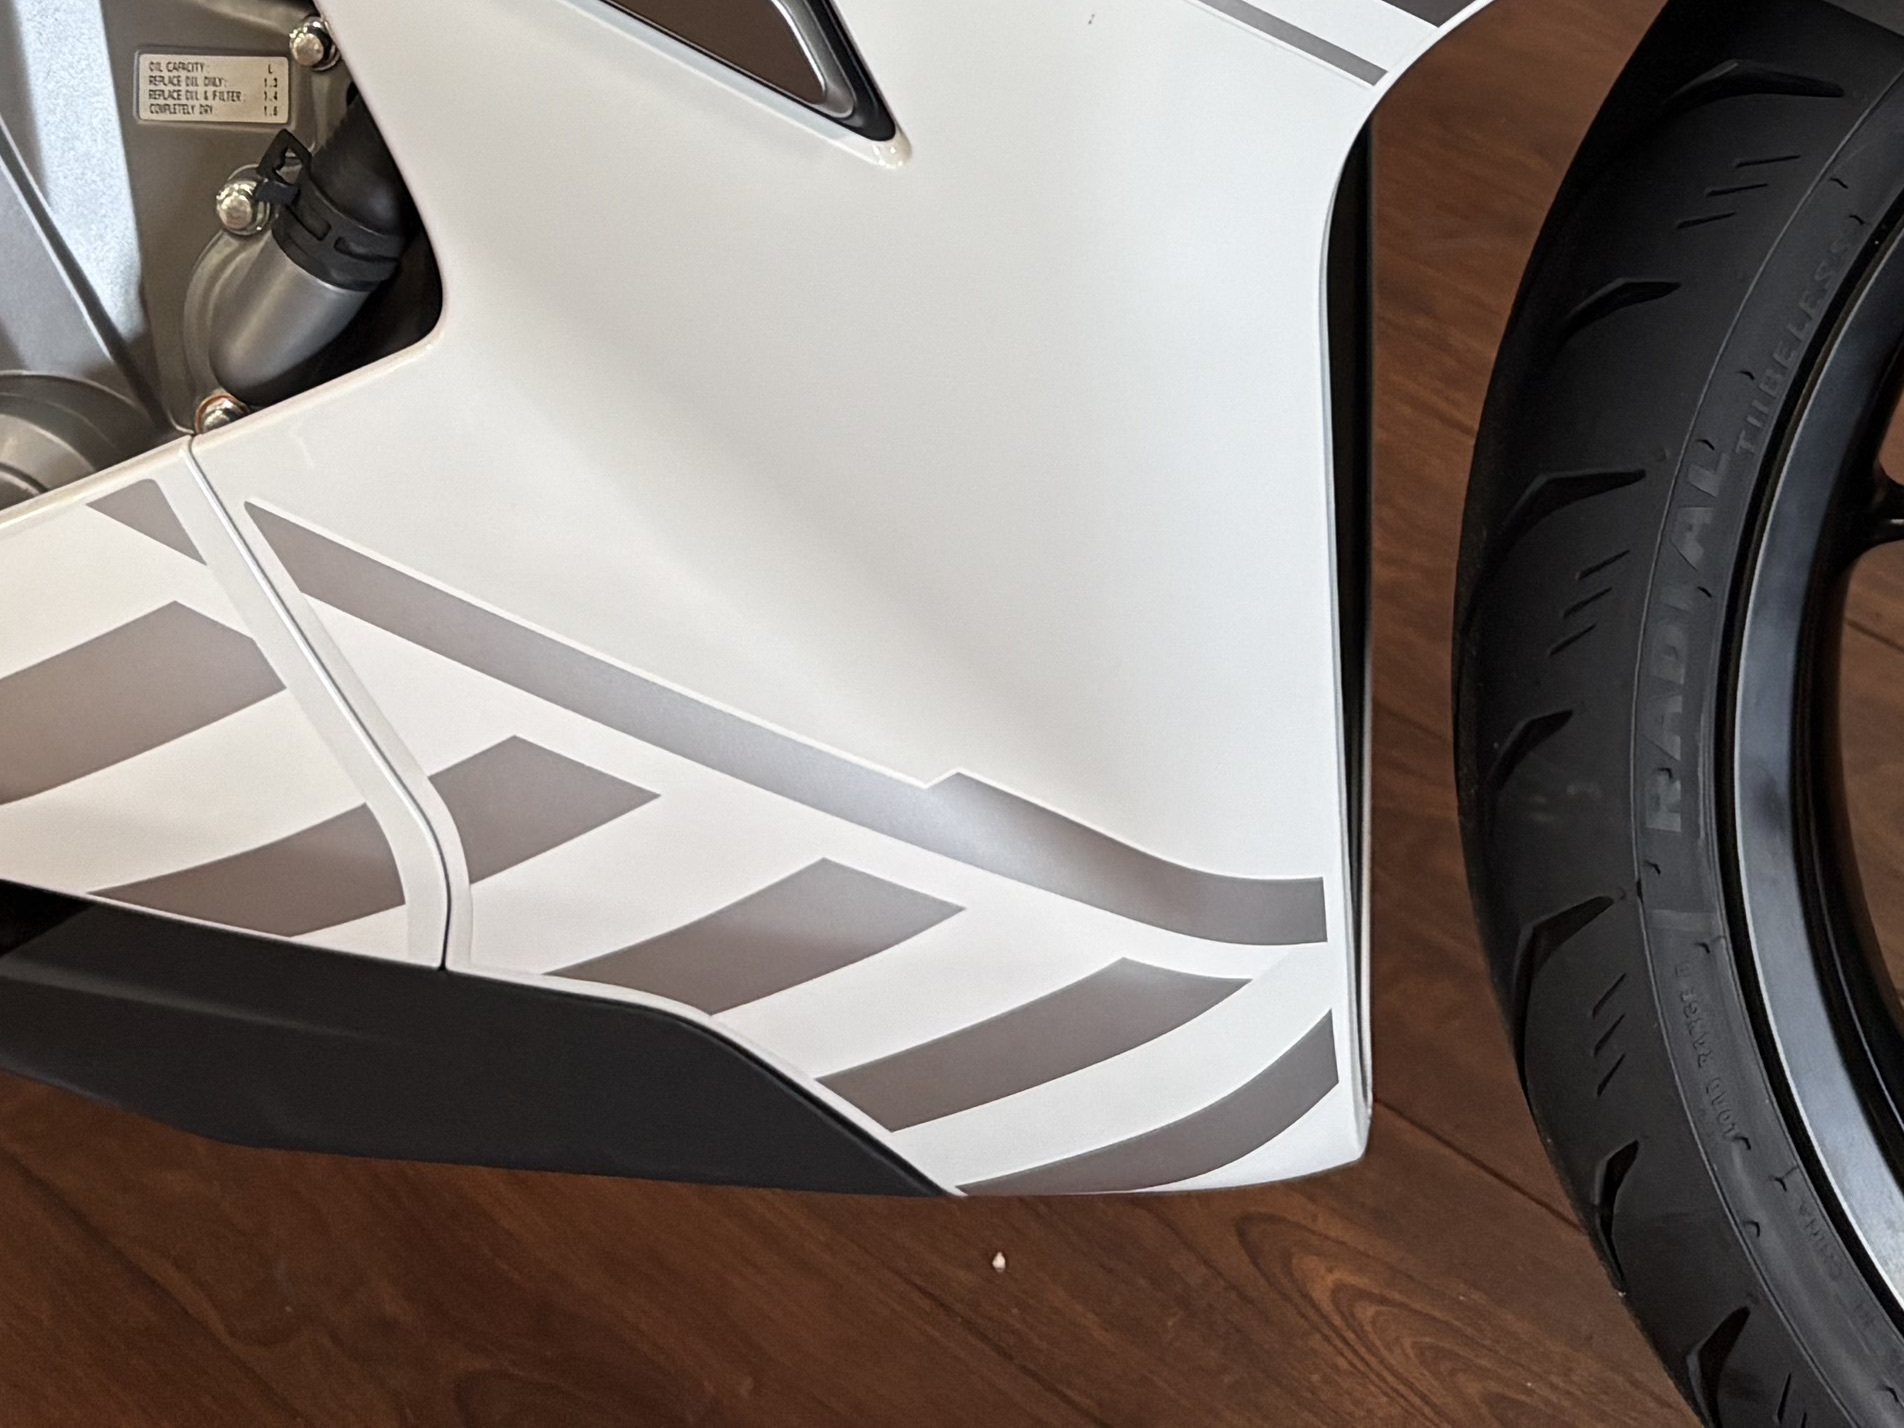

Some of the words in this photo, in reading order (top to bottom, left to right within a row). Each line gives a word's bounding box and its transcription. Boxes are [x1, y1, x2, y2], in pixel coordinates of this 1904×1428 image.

[148, 60, 163, 73] OIL
[148, 74, 182, 88] REPLACE
[185, 75, 199, 88] OIL
[148, 88, 182, 102] REPLACE
[185, 89, 199, 102] OIL
[1641, 451, 1729, 834] RADIAL
